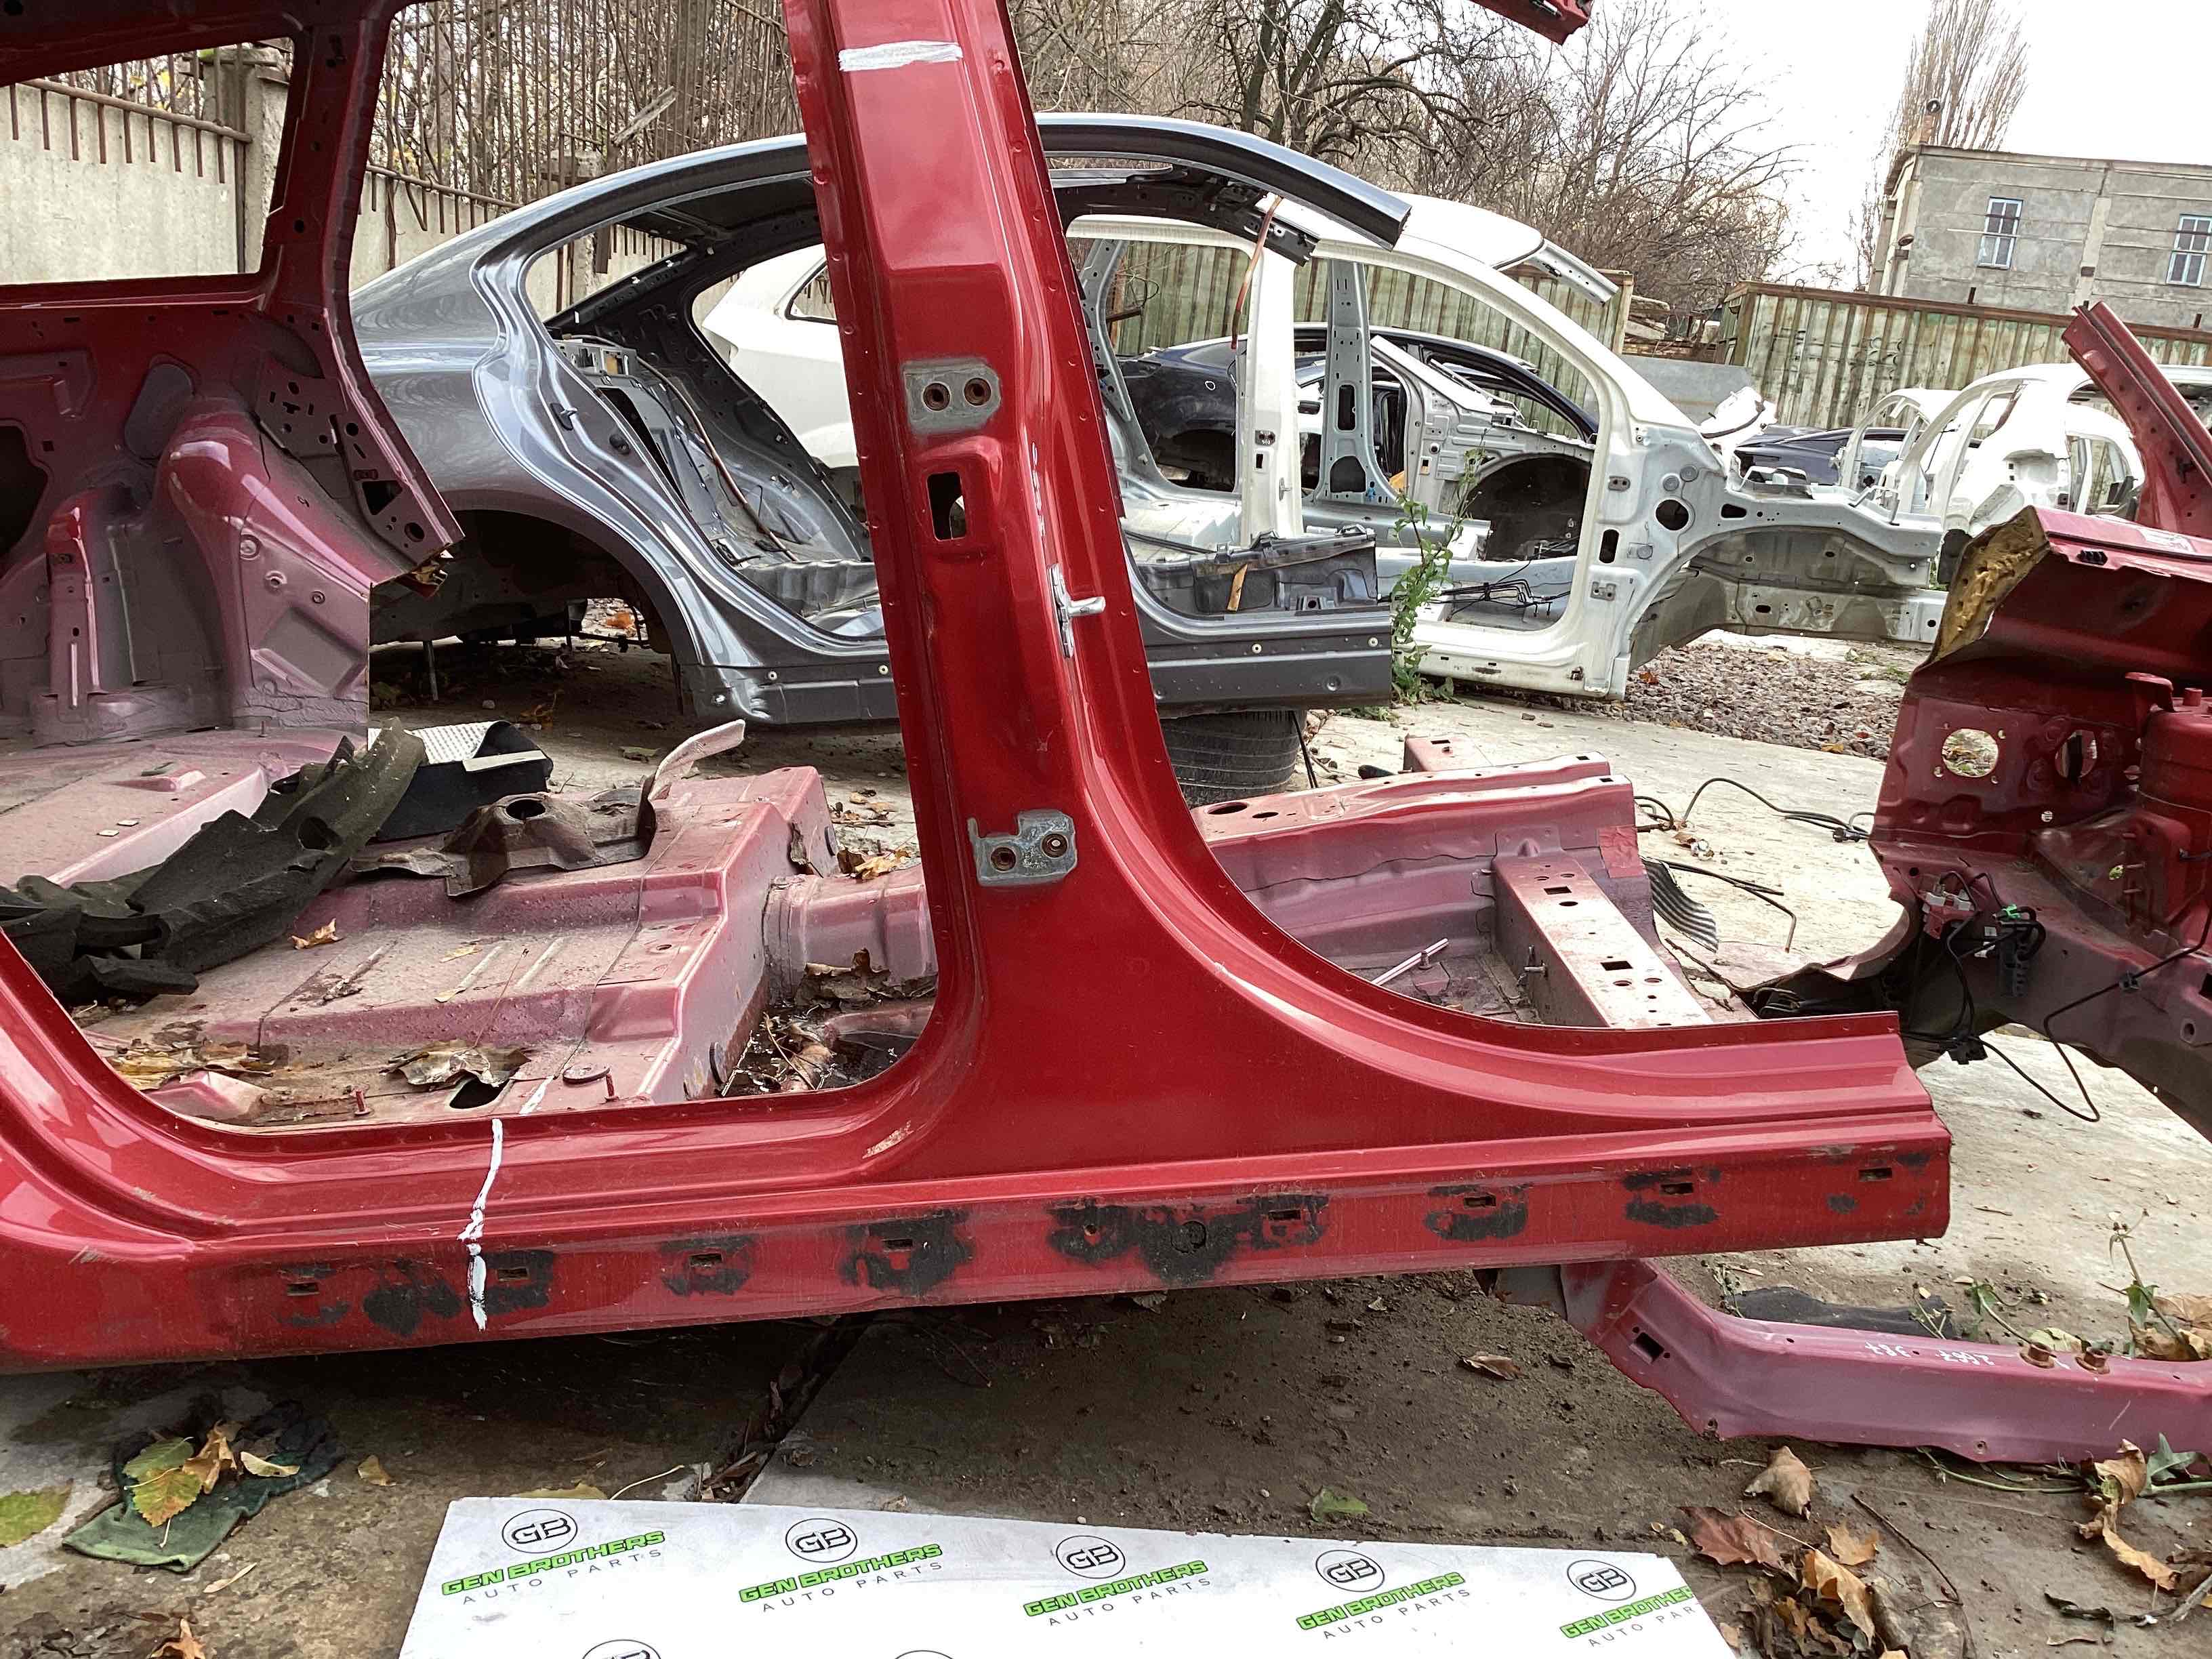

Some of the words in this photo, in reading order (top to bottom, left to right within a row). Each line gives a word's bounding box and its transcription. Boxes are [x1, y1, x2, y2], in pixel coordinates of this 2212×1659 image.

[511, 1517, 571, 1544] GB
[795, 1528, 851, 1553] GB
[441, 1569, 504, 1596] GEN
[508, 1531, 665, 1581] BROTHERS
[463, 1578, 542, 1605] AUTO
[567, 1549, 661, 1578] PARTS
[739, 1577, 798, 1603] GEN
[798, 1544, 943, 1589] BROTHERS
[1067, 1545, 1118, 1569] GB
[1327, 1559, 1377, 1582] GB
[1579, 1568, 1627, 1592] GB
[762, 1588, 834, 1612] AUTO
[857, 1562, 942, 1589] PARTS
[1023, 1593, 1078, 1616] GEN
[1076, 1560, 1208, 1603] BROTHERS
[1049, 1603, 1113, 1626] AUTO
[1132, 1578, 1210, 1603] PARTS
[1296, 1605, 1348, 1630] GEN
[1344, 1572, 1465, 1616] BROTHERS
[1324, 1616, 1382, 1639] AUTO
[1398, 1589, 1470, 1615] PARTS
[1559, 1615, 1608, 1638] GEN
[1588, 1624, 1643, 1647] AUTO
